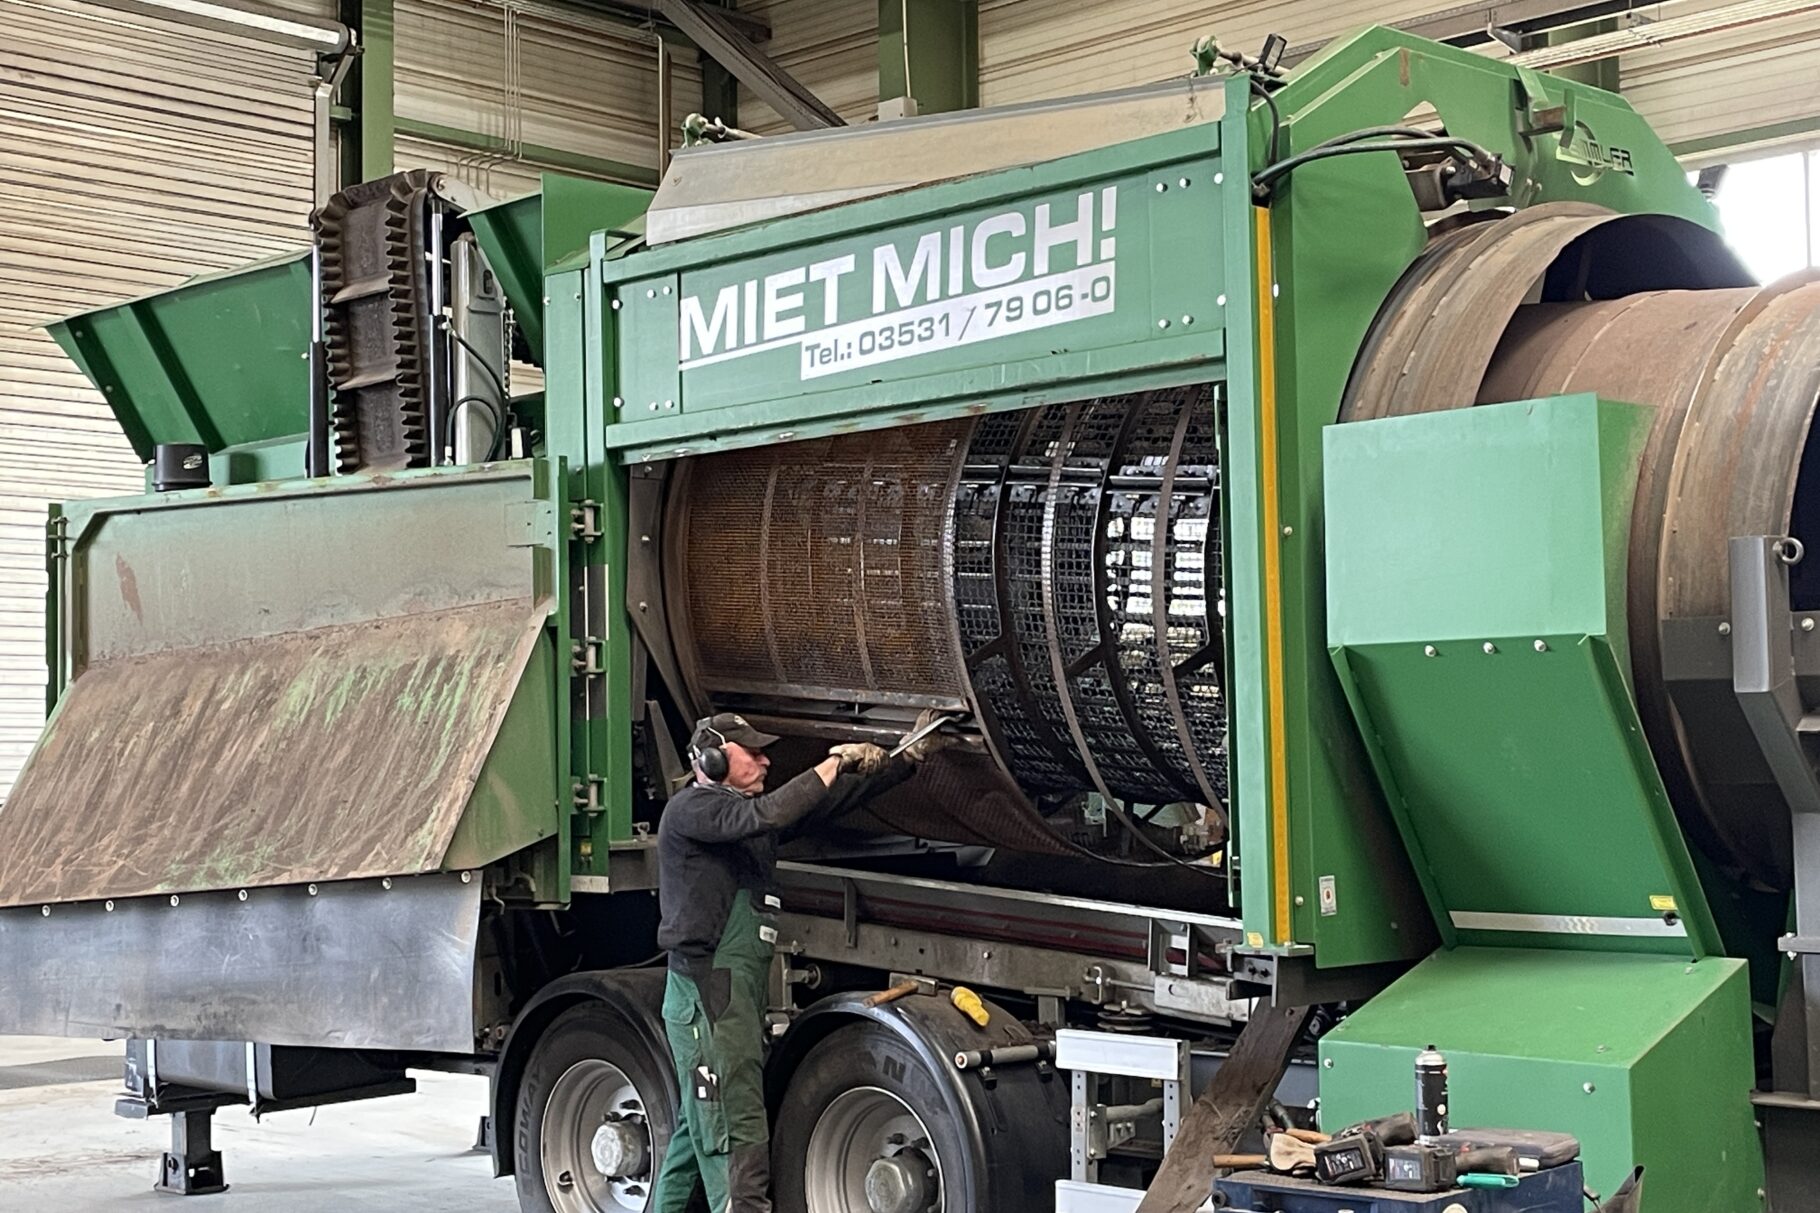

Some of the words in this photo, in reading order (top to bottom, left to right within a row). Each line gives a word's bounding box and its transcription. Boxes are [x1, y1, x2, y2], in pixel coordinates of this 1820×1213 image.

[680, 253, 856, 361] MIET
[872, 185, 1118, 316] MICH!
[805, 338, 852, 368] Tel.:
[859, 312, 951, 356] 03531
